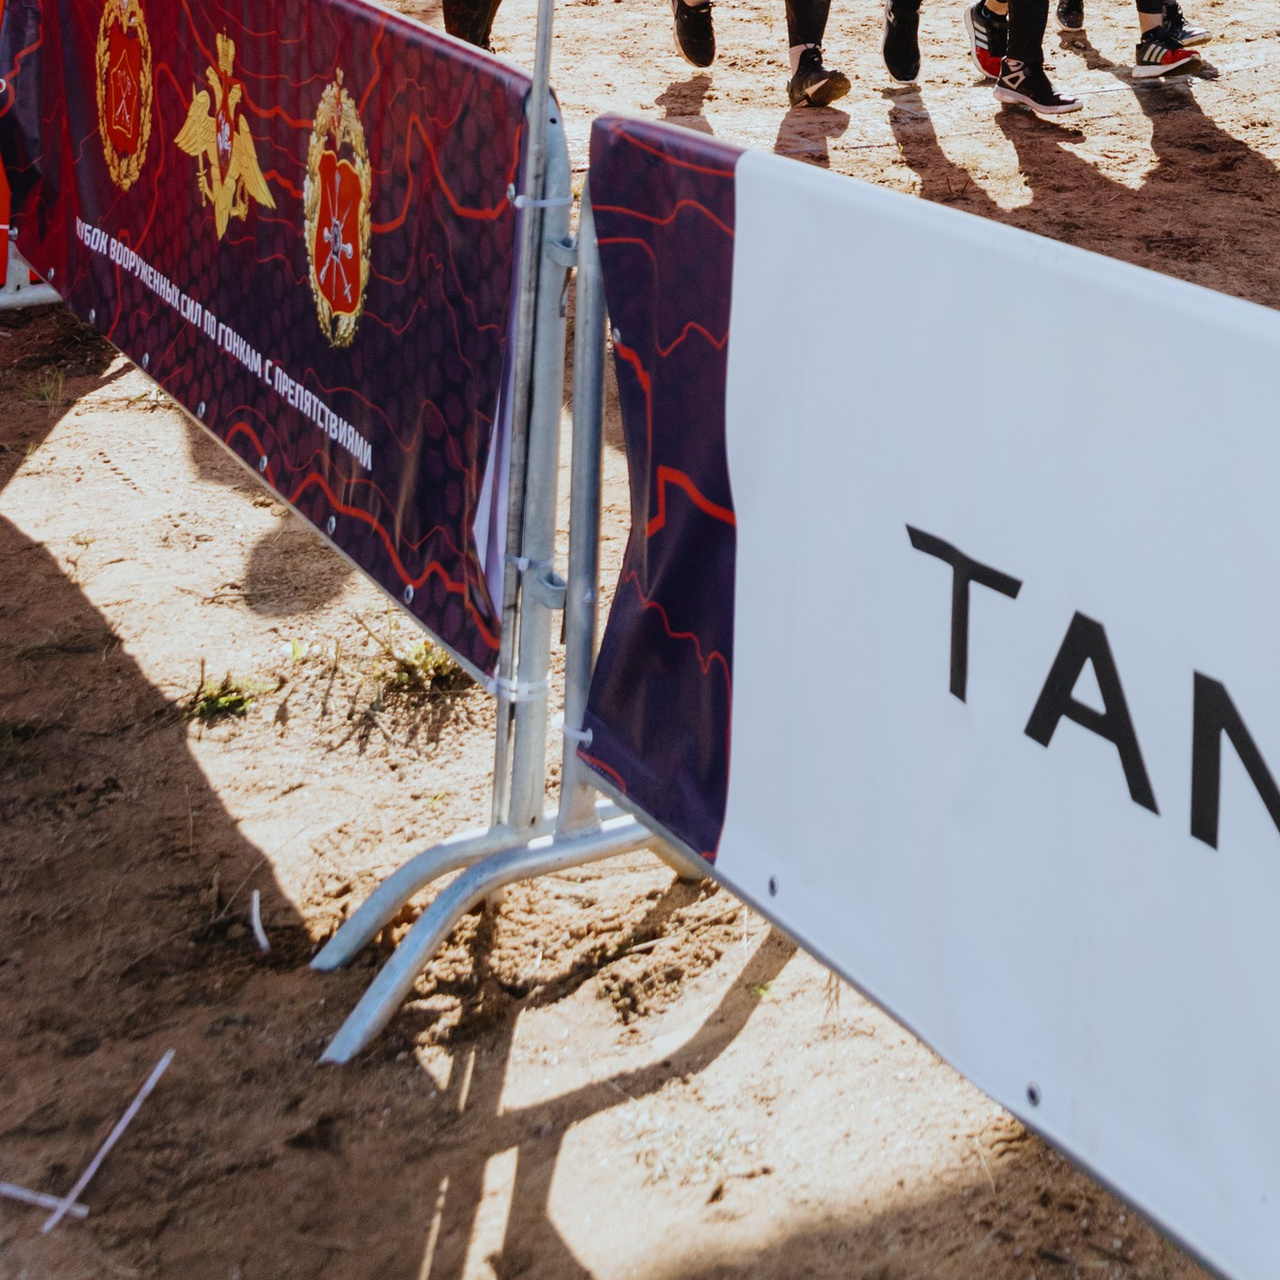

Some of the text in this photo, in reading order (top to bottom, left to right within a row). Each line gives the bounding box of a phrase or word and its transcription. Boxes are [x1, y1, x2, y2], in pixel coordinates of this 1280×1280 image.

[76, 216, 372, 471] КУБОК ВООРУЖЕННЫХ СИЛ ПО ГОНКАМ С ПРЕПЯТСТВИЯМИ
